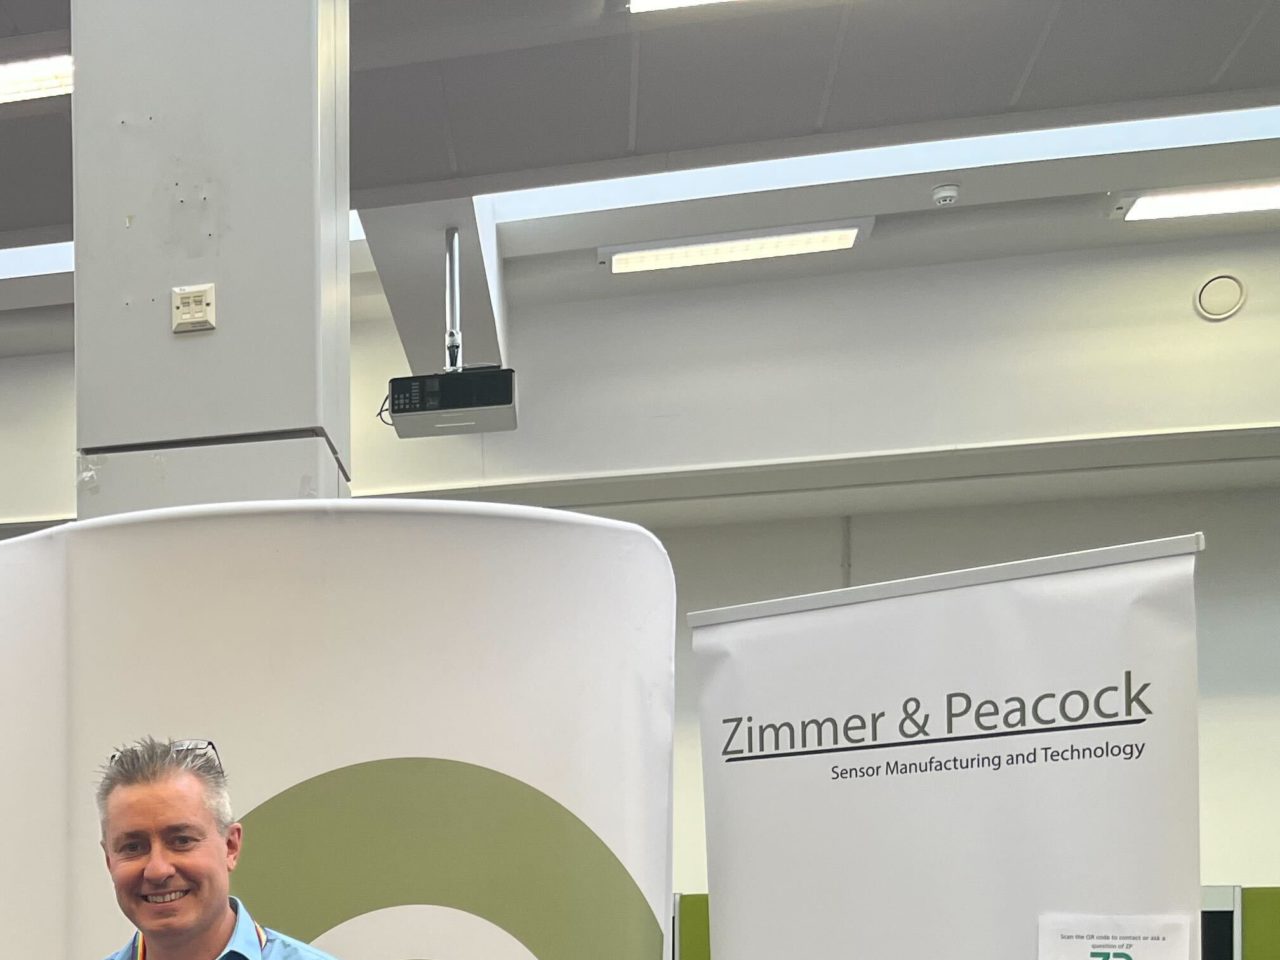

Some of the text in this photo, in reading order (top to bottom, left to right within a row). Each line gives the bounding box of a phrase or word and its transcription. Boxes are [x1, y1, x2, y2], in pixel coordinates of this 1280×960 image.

[721, 670, 1153, 757] Zimmer & Peacock
[830, 740, 1146, 781] Sensor Manufacturing and Technology
